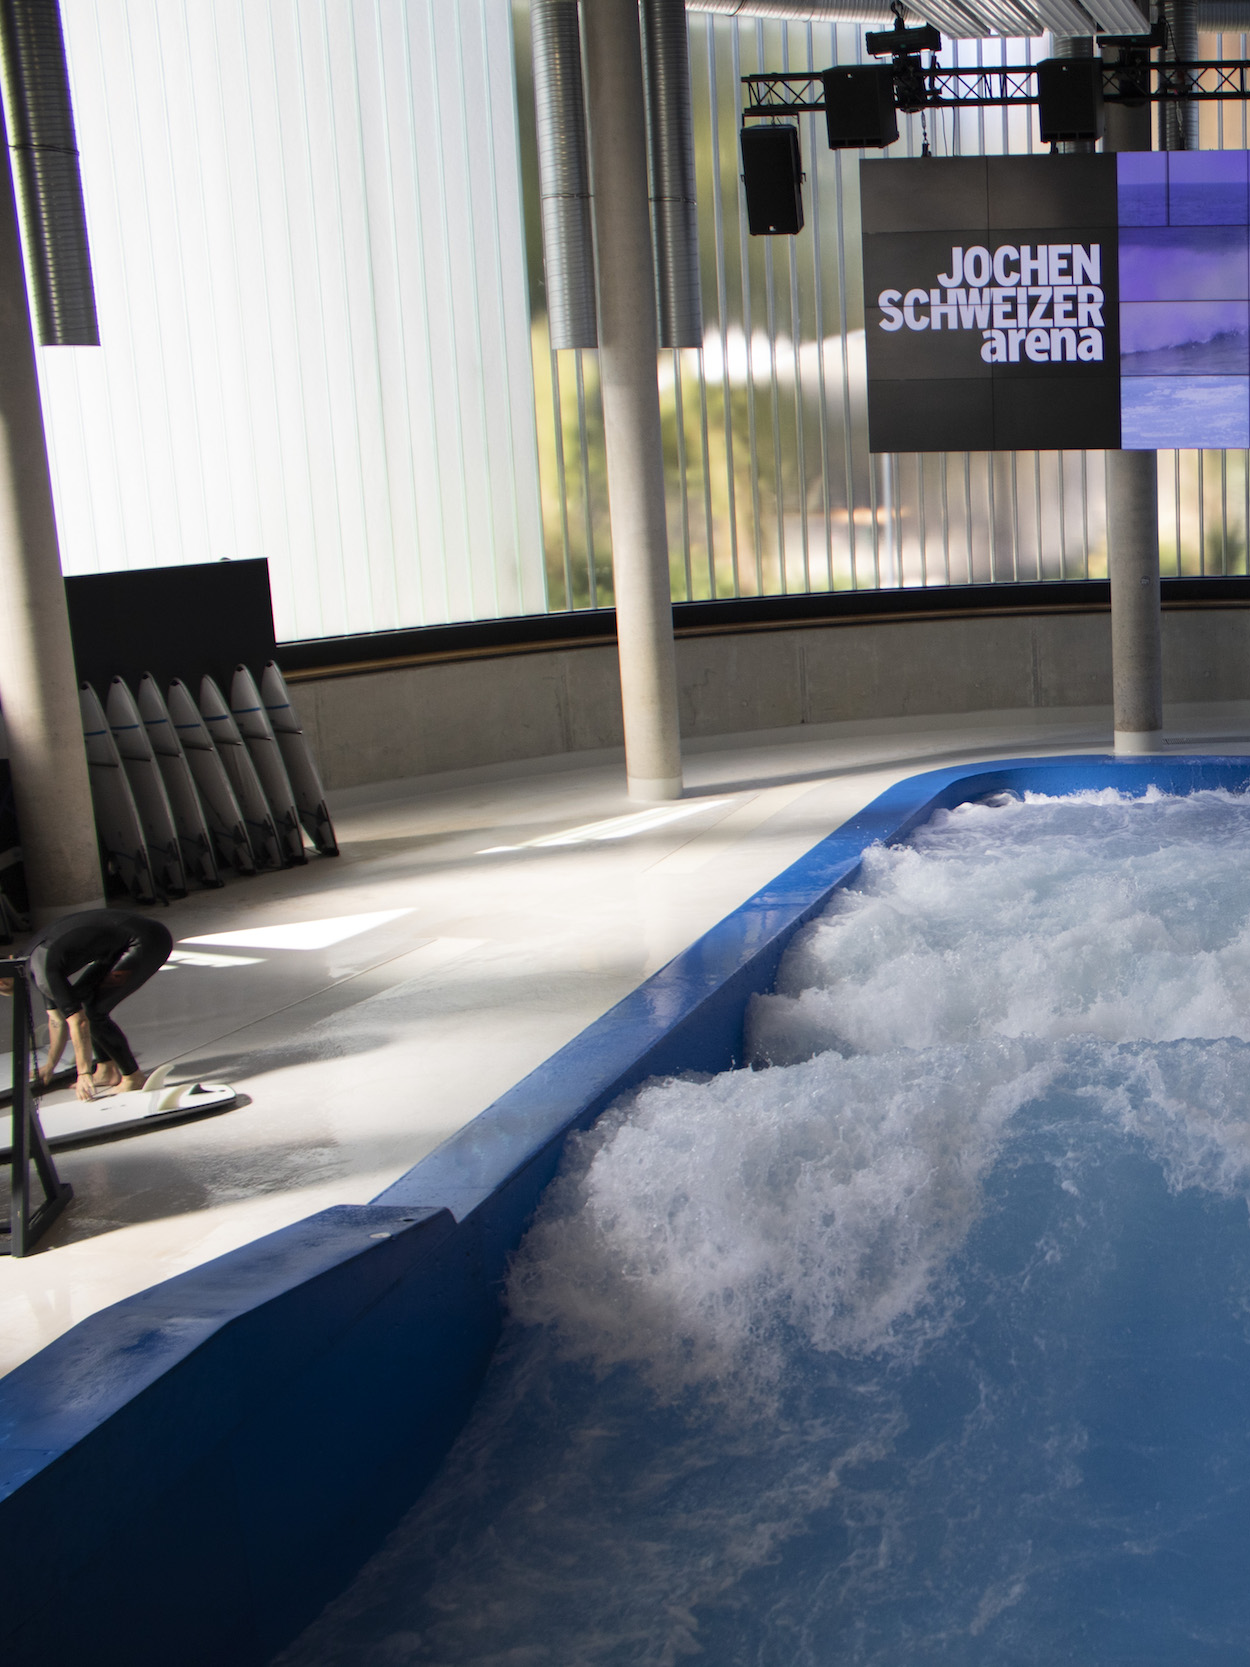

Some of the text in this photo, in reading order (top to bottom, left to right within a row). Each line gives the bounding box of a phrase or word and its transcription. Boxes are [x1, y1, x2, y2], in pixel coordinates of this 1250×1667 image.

[936, 243, 1101, 289] JOCHEN
[877, 285, 1105, 332] SCHWEIZER
[980, 327, 1103, 363] arena
